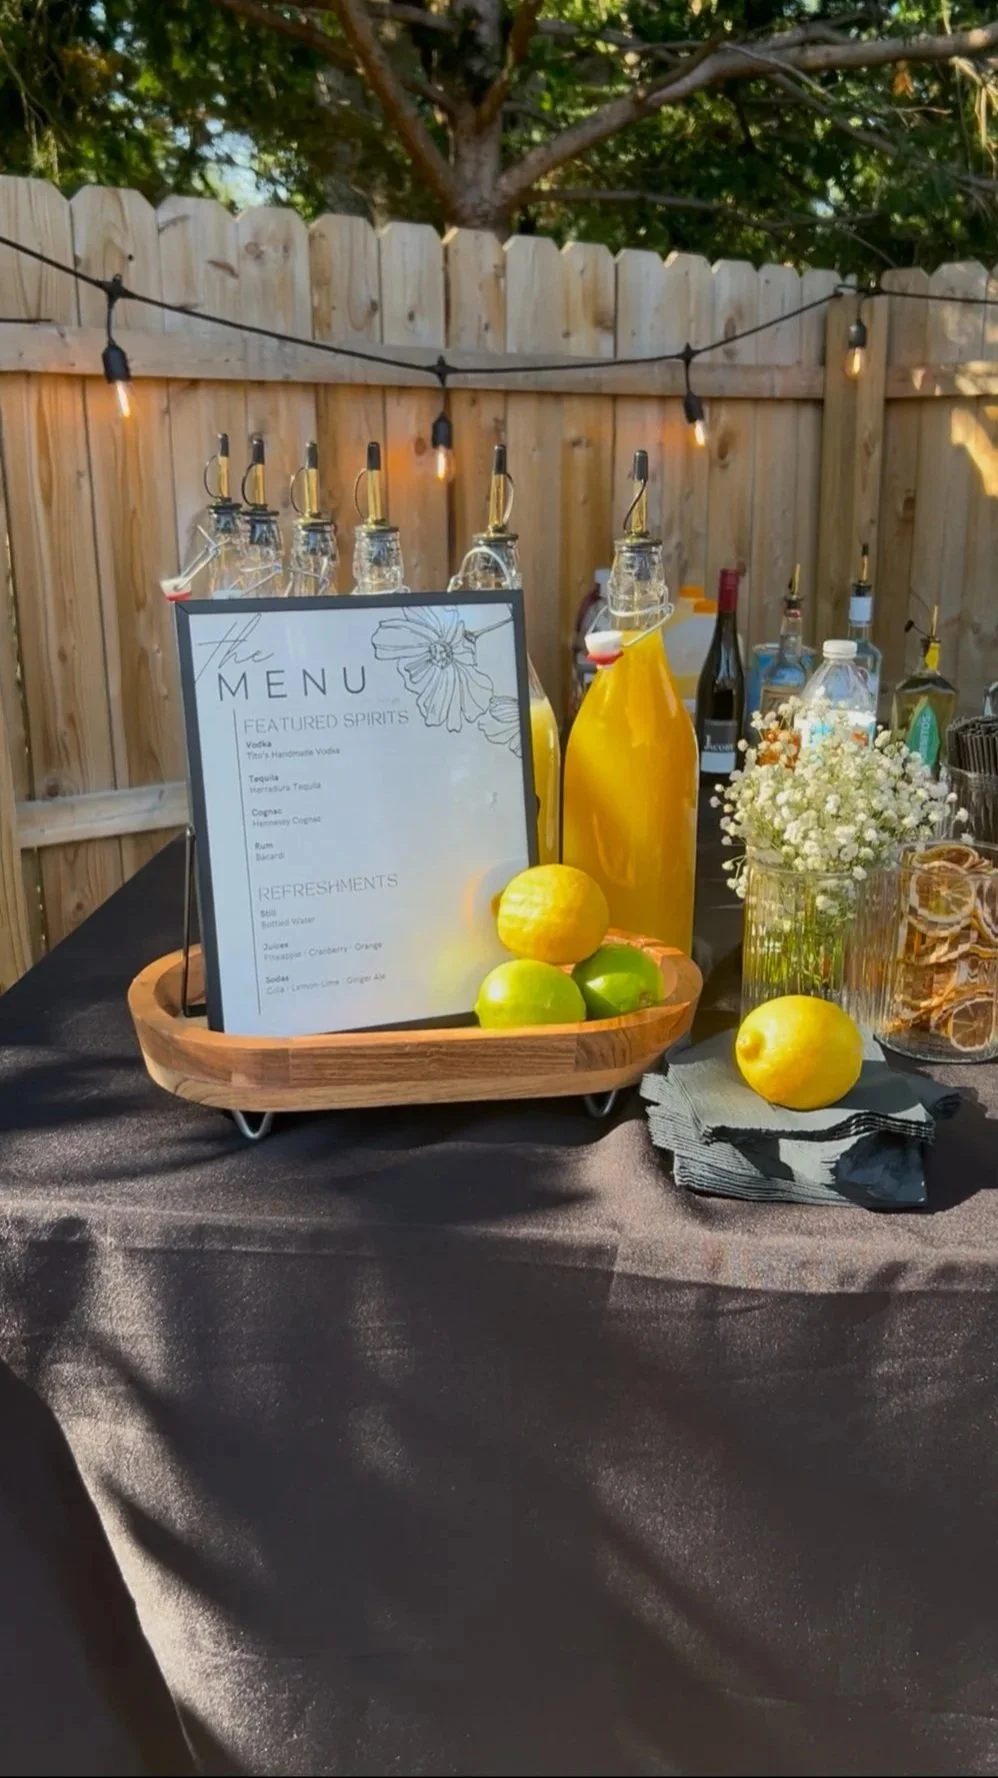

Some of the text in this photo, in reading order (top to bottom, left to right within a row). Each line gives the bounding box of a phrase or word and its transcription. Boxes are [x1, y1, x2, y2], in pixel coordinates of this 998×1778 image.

[217, 665, 366, 701] MENU
[243, 710, 409, 734] FEATURED SPIRITS
[246, 741, 272, 749] Vodka
[247, 748, 341, 760] Tito's Handmade Vodka
[249, 774, 279, 784] Tequila
[293, 782, 322, 791] Tequila
[251, 808, 283, 818] Cognac
[252, 816, 322, 828] Hennessy Cognac
[255, 842, 274, 850] Rum
[255, 852, 285, 861] Bacardi
[258, 873, 398, 901] REFRESHMENTS
[260, 909, 276, 918] Still
[261, 916, 316, 929] Bottled Water
[263, 942, 289, 951] Juices
[308, 946, 348, 957] Cranberry
[354, 942, 383, 951] Orange
[265, 975, 289, 984] Sodas
[346, 975, 372, 985] Ginger
[373, 973, 386, 981] Ale
